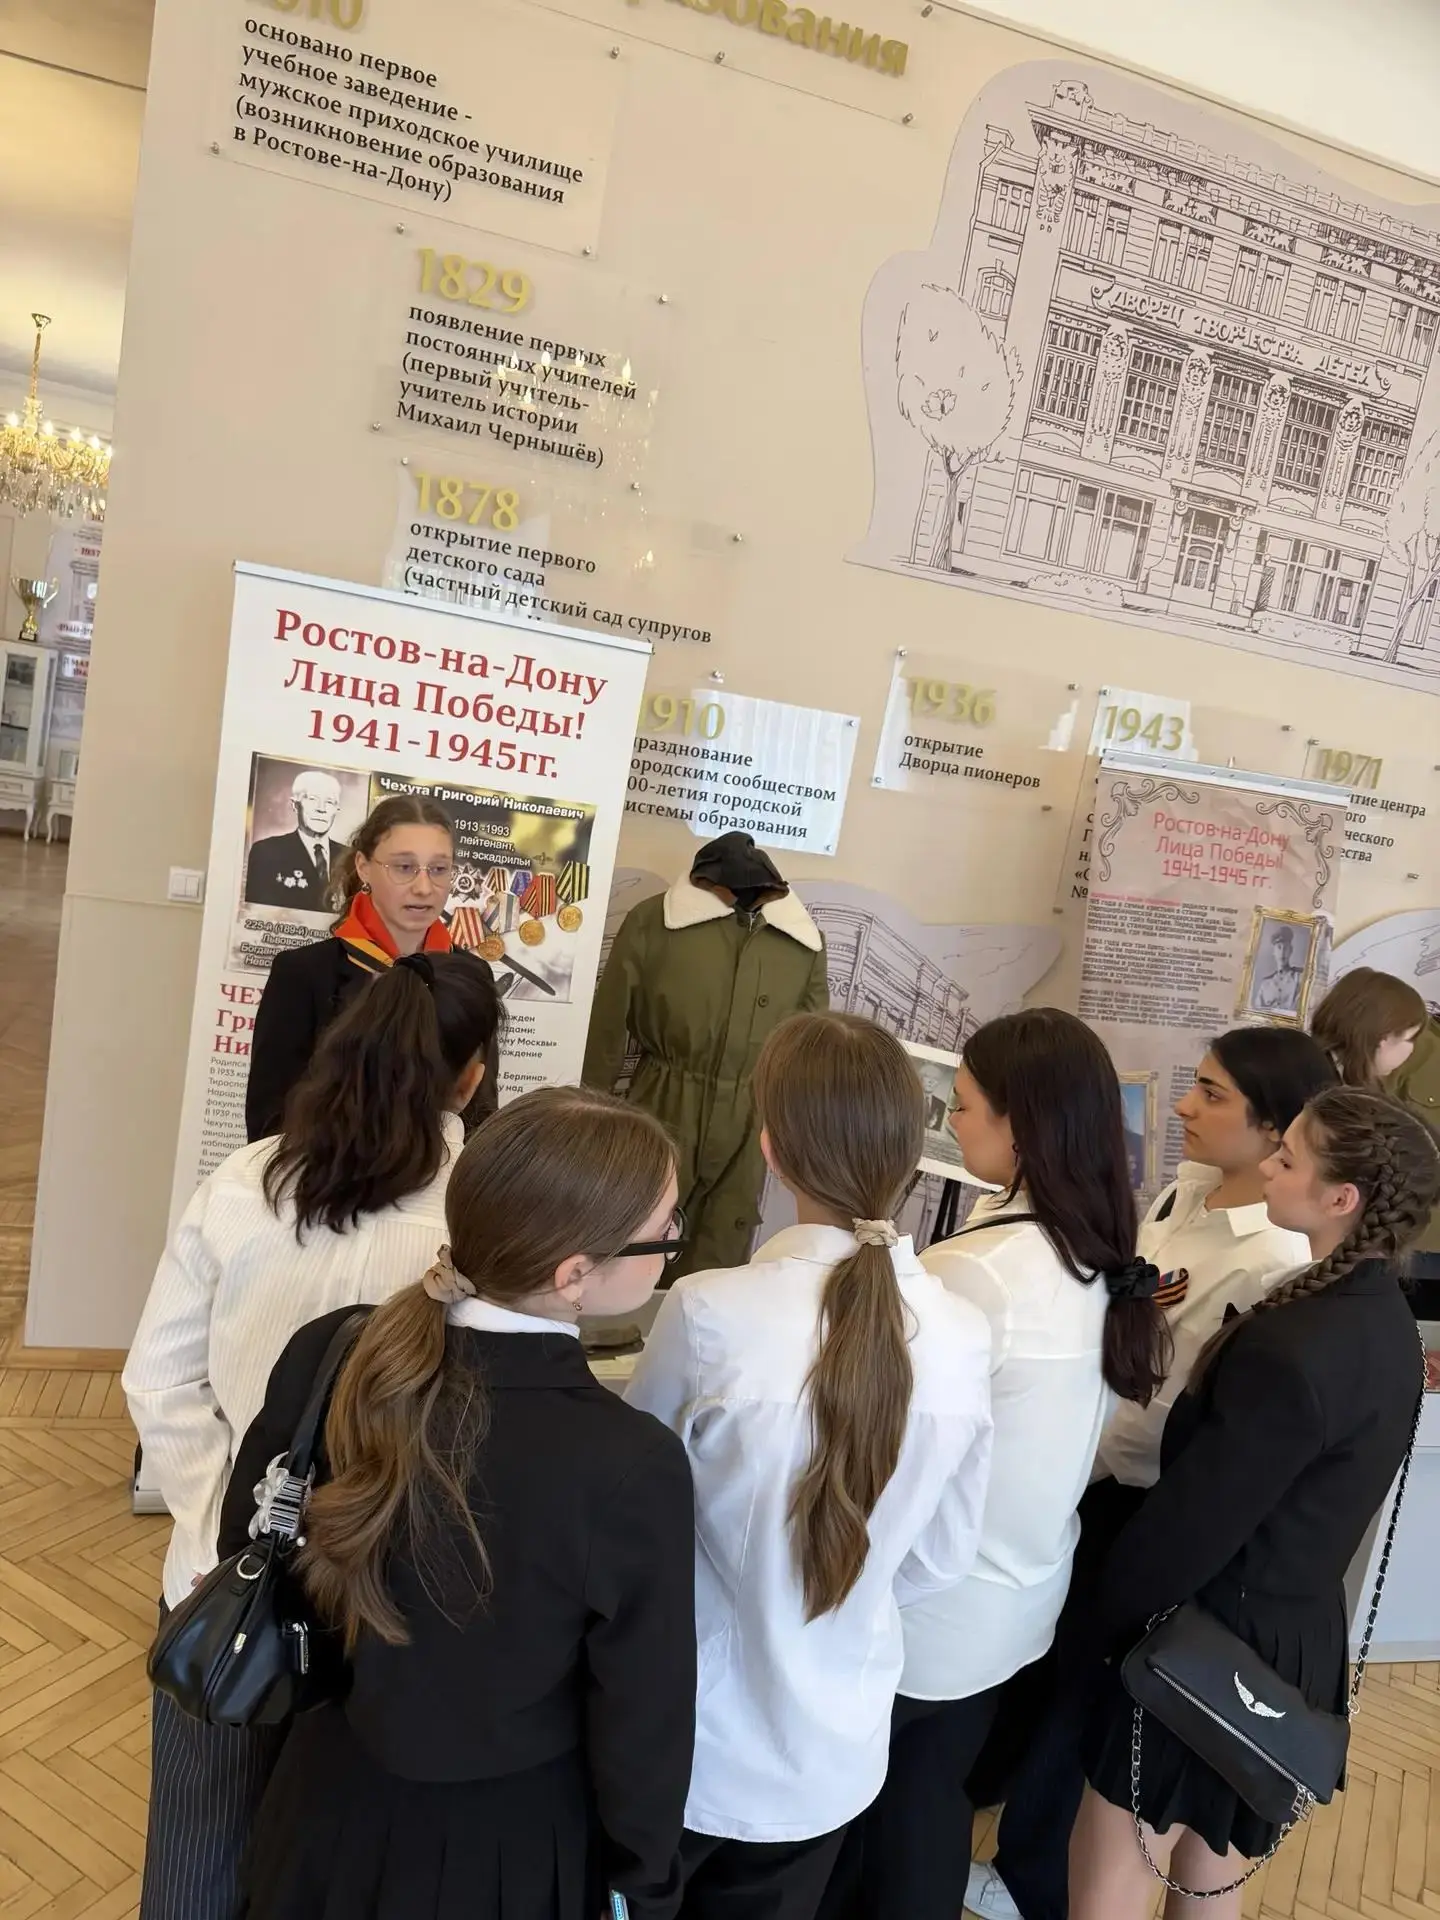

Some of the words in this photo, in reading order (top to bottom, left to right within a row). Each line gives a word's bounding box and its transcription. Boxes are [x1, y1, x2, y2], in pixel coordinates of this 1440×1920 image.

[244, 18, 354, 62] основано
[359, 53, 438, 88] первое
[627, 0, 909, 76] ования
[240, 44, 338, 86] учебное
[344, 76, 458, 122] заведение
[235, 95, 423, 164] (возникновение
[428, 153, 565, 204] образования
[239, 72, 342, 114] мужское
[348, 103, 480, 154] приходское
[485, 142, 584, 183] училище
[233, 125, 246, 141] в
[252, 127, 453, 203] Ростове-на-Дону)
[418, 248, 532, 314] 1829
[409, 306, 525, 346] появление
[529, 336, 607, 368] первых
[402, 352, 493, 389] (первый
[498, 378, 590, 412] учитель-
[405, 331, 536, 375] постоянных
[542, 365, 638, 401] учителей
[399, 379, 487, 413] учитель
[492, 403, 579, 435] истории
[396, 402, 481, 437] Михаил
[488, 423, 605, 469] Чернышёв)
[415, 472, 520, 532] 1878
[406, 547, 498, 577] детского
[503, 566, 546, 587] сада
[410, 522, 512, 555] открытие
[517, 546, 597, 574] первого
[404, 566, 501, 602] (частный
[505, 590, 588, 620] детский
[592, 608, 623, 628] сад
[627, 616, 712, 645] супругов
[274, 609, 609, 705] Ростов-на-Дону
[284, 659, 401, 708] Лица
[413, 681, 587, 741] Победы!
[910, 676, 997, 724] 1936
[308, 710, 559, 779] 1941-1945гг.
[903, 735, 984, 760] открытие
[1104, 706, 1185, 751] 1943
[380, 777, 430, 797] Чехута
[434, 785, 500, 808] Григорий
[503, 798, 585, 820] Николаевич
[627, 776, 709, 802] 00-летия
[712, 790, 804, 819] городской
[630, 758, 718, 783] ородским
[723, 771, 837, 803] сообществом
[898, 752, 960, 778] Дворца
[963, 766, 1041, 791] пионеров
[454, 819, 479, 832] 1913
[624, 800, 694, 821] истемы
[698, 810, 808, 839] образования
[1153, 812, 1291, 851] Ростов-на-Дону
[1380, 799, 1426, 818] центра
[460, 835, 515, 852] лейтенант,
[472, 851, 531, 866] эскадрильи
[1155, 837, 1204, 857] Лица
[1209, 842, 1284, 869] Победы!
[1344, 830, 1394, 847] ческого
